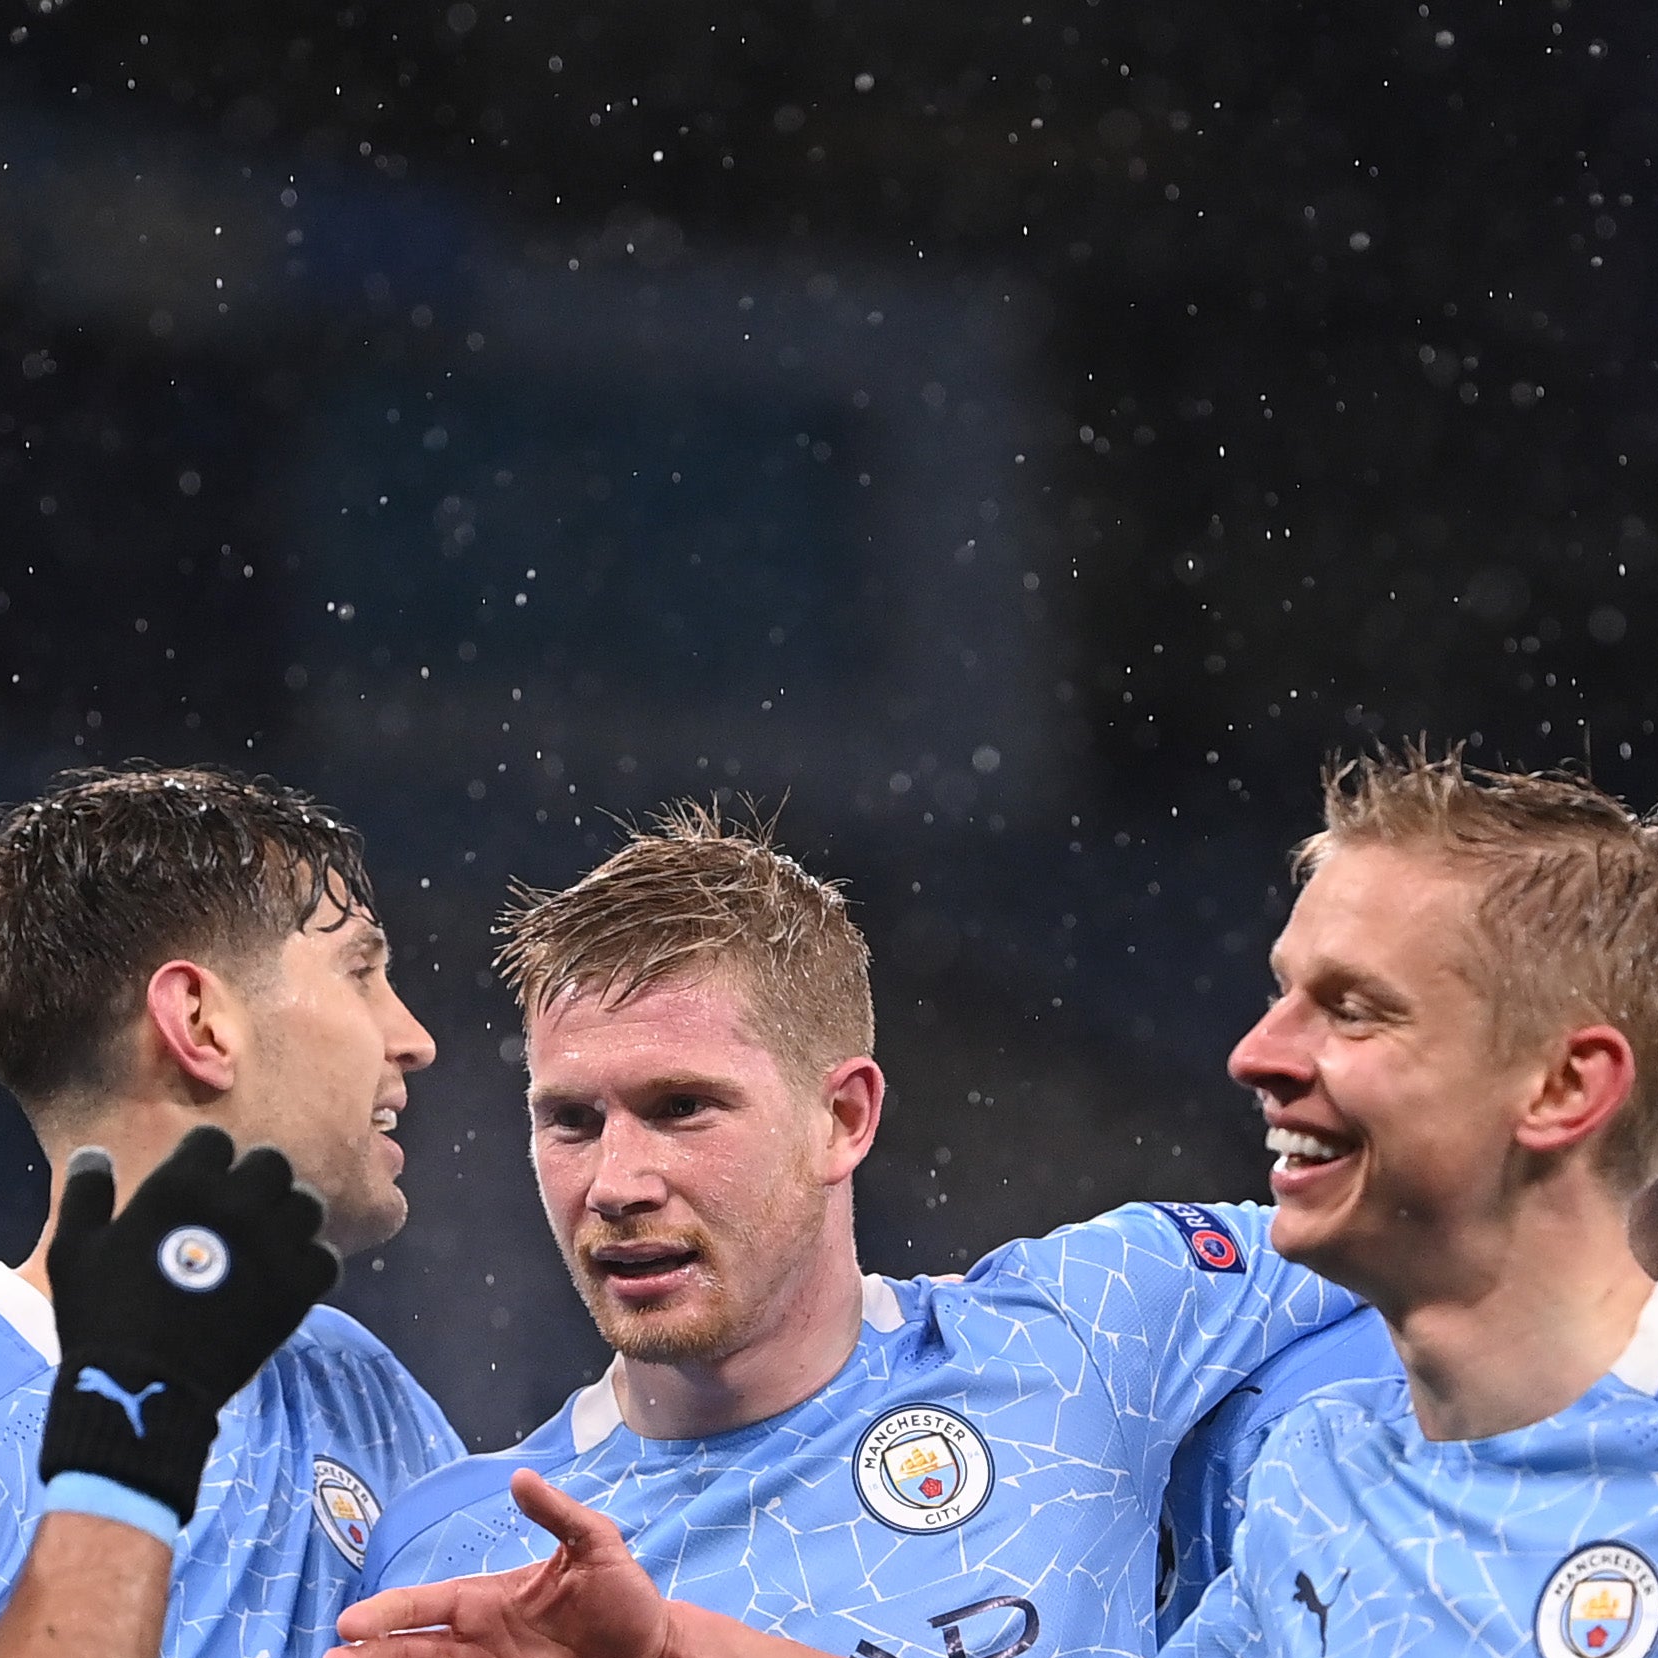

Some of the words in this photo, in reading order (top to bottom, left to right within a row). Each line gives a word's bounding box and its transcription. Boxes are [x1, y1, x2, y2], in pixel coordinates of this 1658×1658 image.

[864, 1414, 965, 1469] MANCHESTER
[314, 1464, 369, 1503] CHESTER
[925, 1505, 961, 1525] CITY
[1554, 1553, 1655, 1596] MANCHESTER
